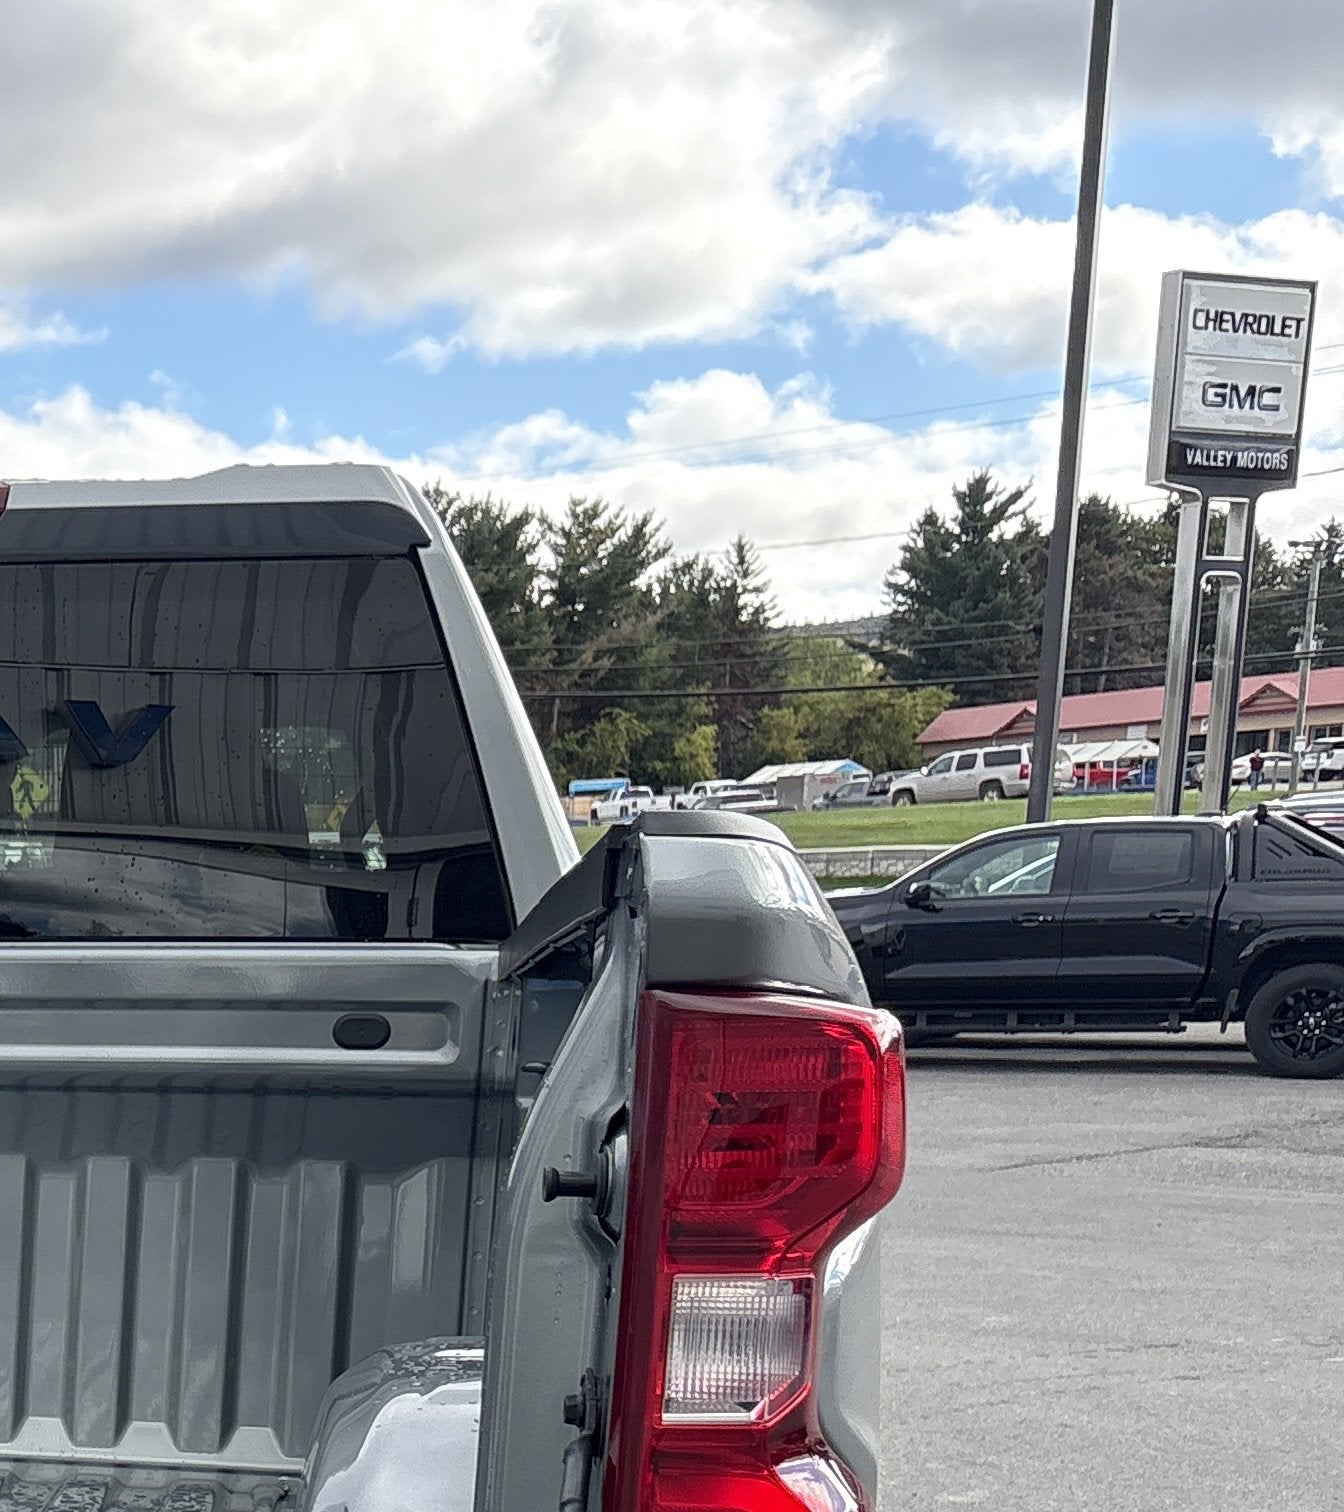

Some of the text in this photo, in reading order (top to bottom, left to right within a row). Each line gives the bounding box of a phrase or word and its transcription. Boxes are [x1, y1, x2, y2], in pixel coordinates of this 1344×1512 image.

[1192, 308, 1305, 339] CHEVROLET
[1201, 381, 1282, 412] GMC
[1186, 448, 1289, 470] VALLEY MOTORS
